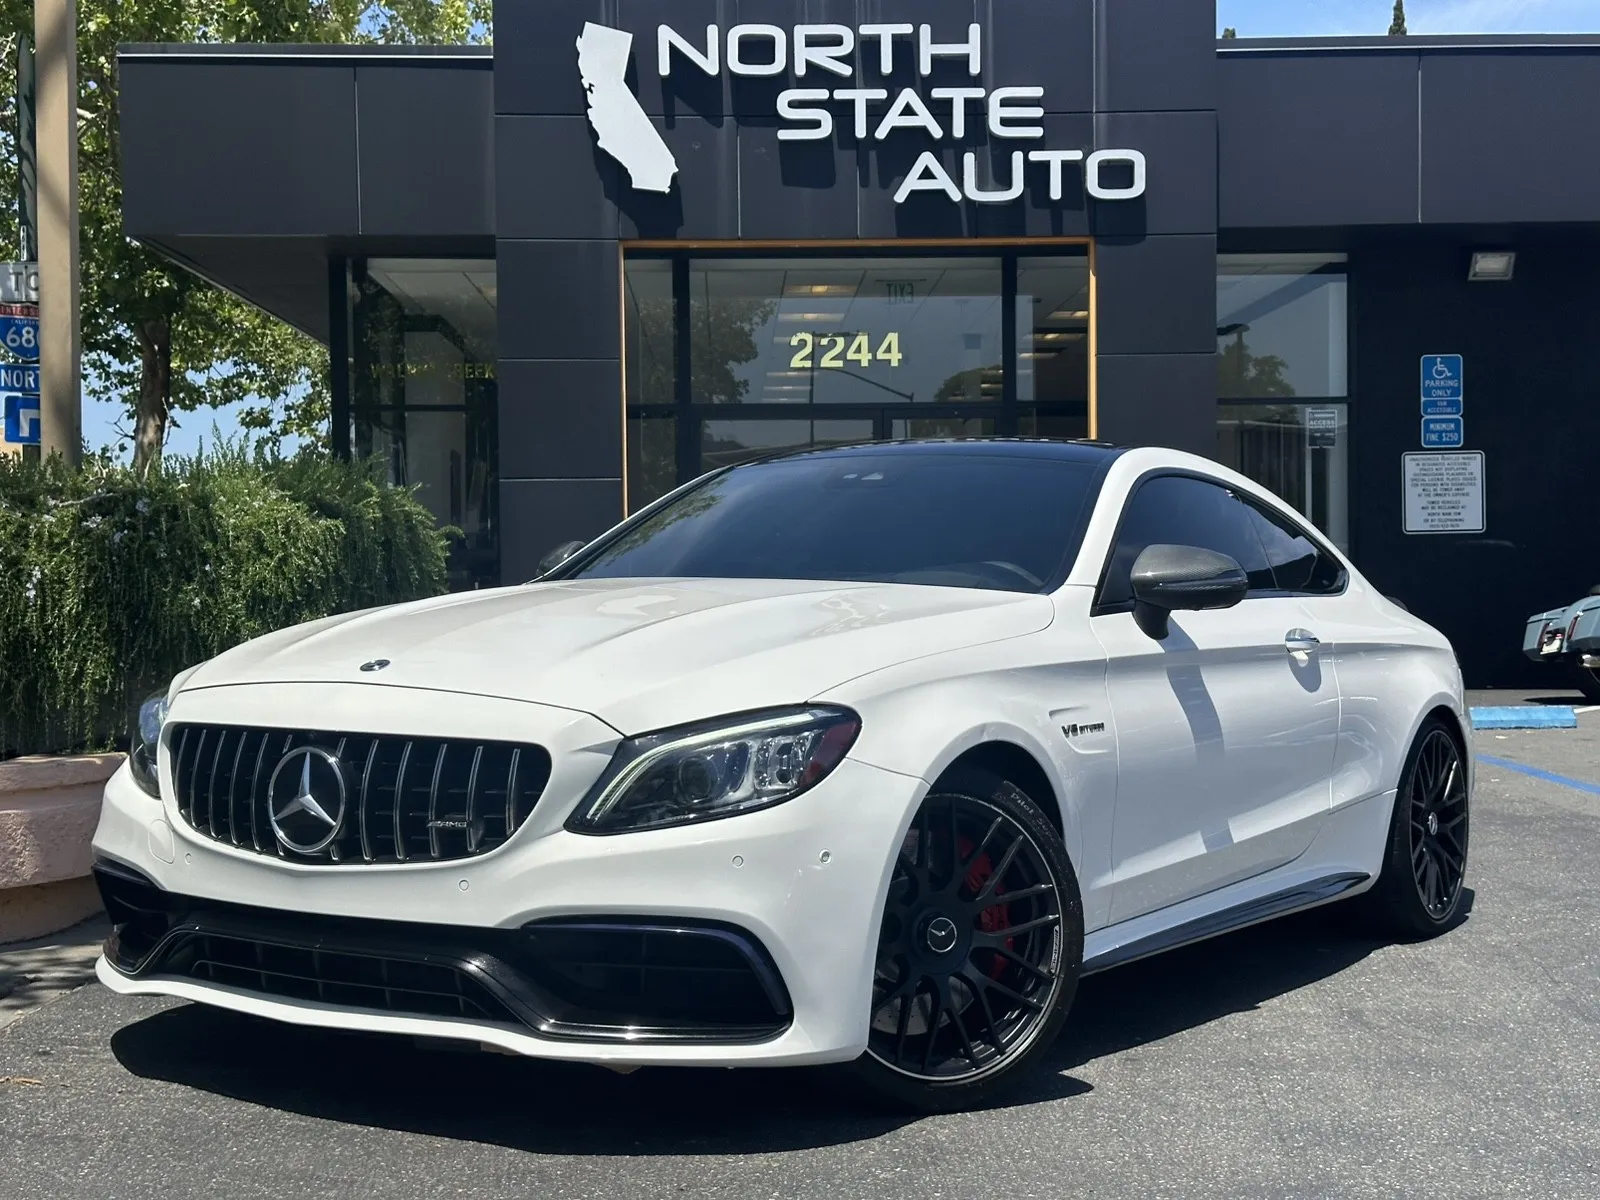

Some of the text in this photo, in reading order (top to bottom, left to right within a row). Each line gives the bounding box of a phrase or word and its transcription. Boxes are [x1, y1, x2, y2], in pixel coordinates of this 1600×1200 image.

[657, 23, 981, 76] NORTH
[776, 86, 1044, 141] STATE
[893, 149, 1147, 203] AUTO
[6, 326, 40, 348] 68
[789, 332, 902, 368] 2244
[1010, 792, 1036, 816] Pilot
